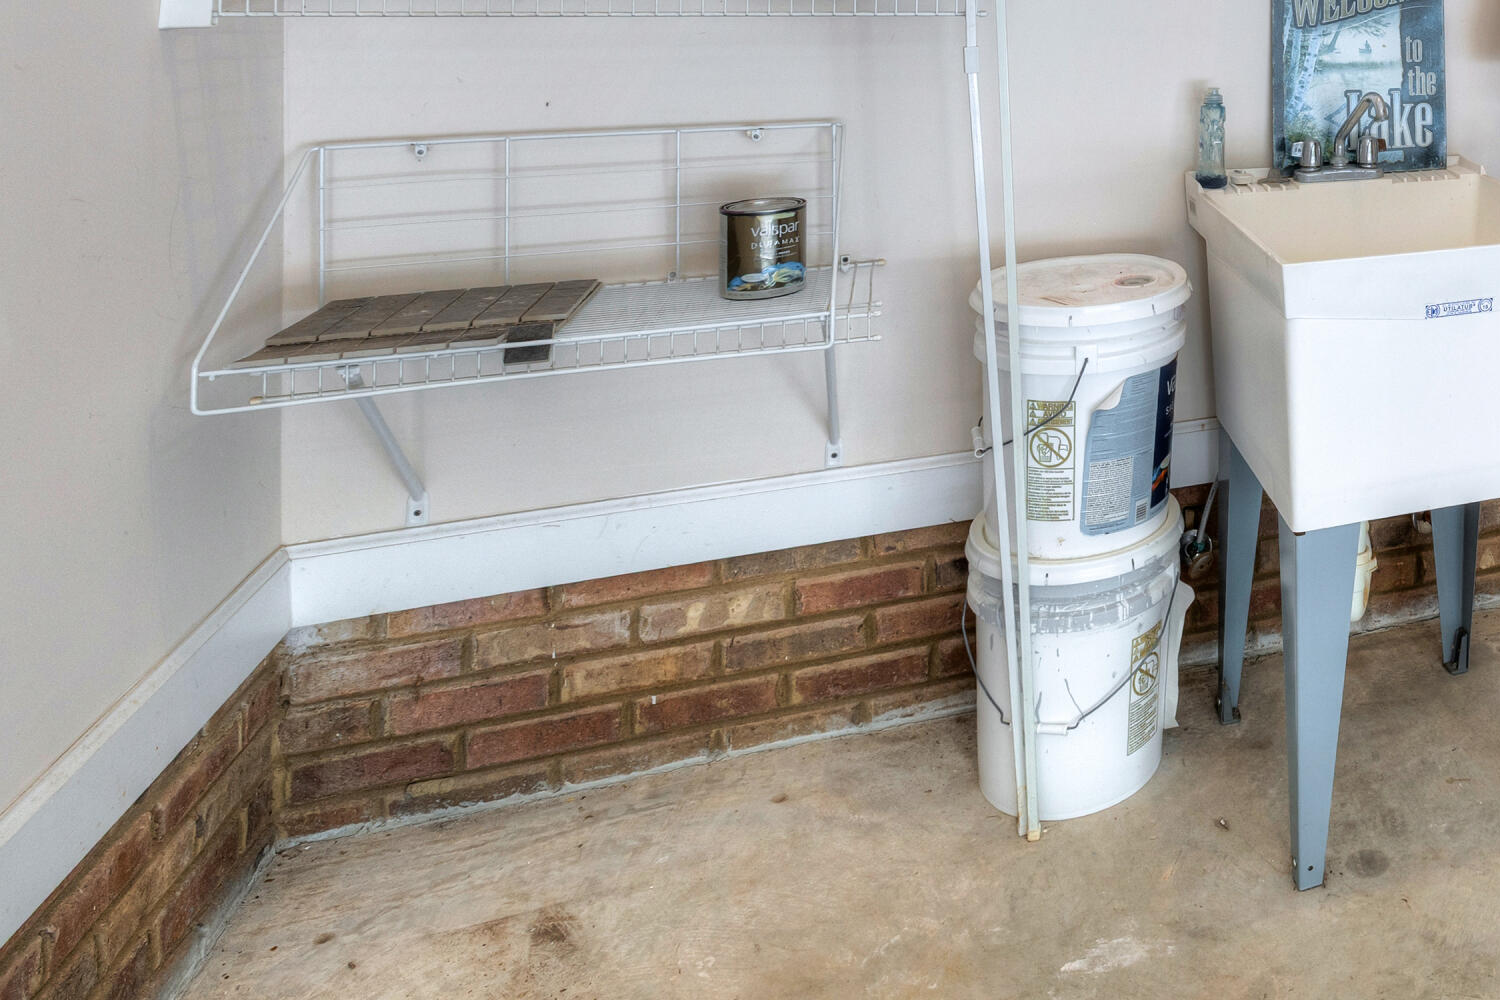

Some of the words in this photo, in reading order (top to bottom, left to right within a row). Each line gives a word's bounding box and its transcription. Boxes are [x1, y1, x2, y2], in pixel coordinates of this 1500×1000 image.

[1405, 35, 1423, 63] to
[1407, 66, 1437, 96] the
[750, 220, 800, 238] valspar
